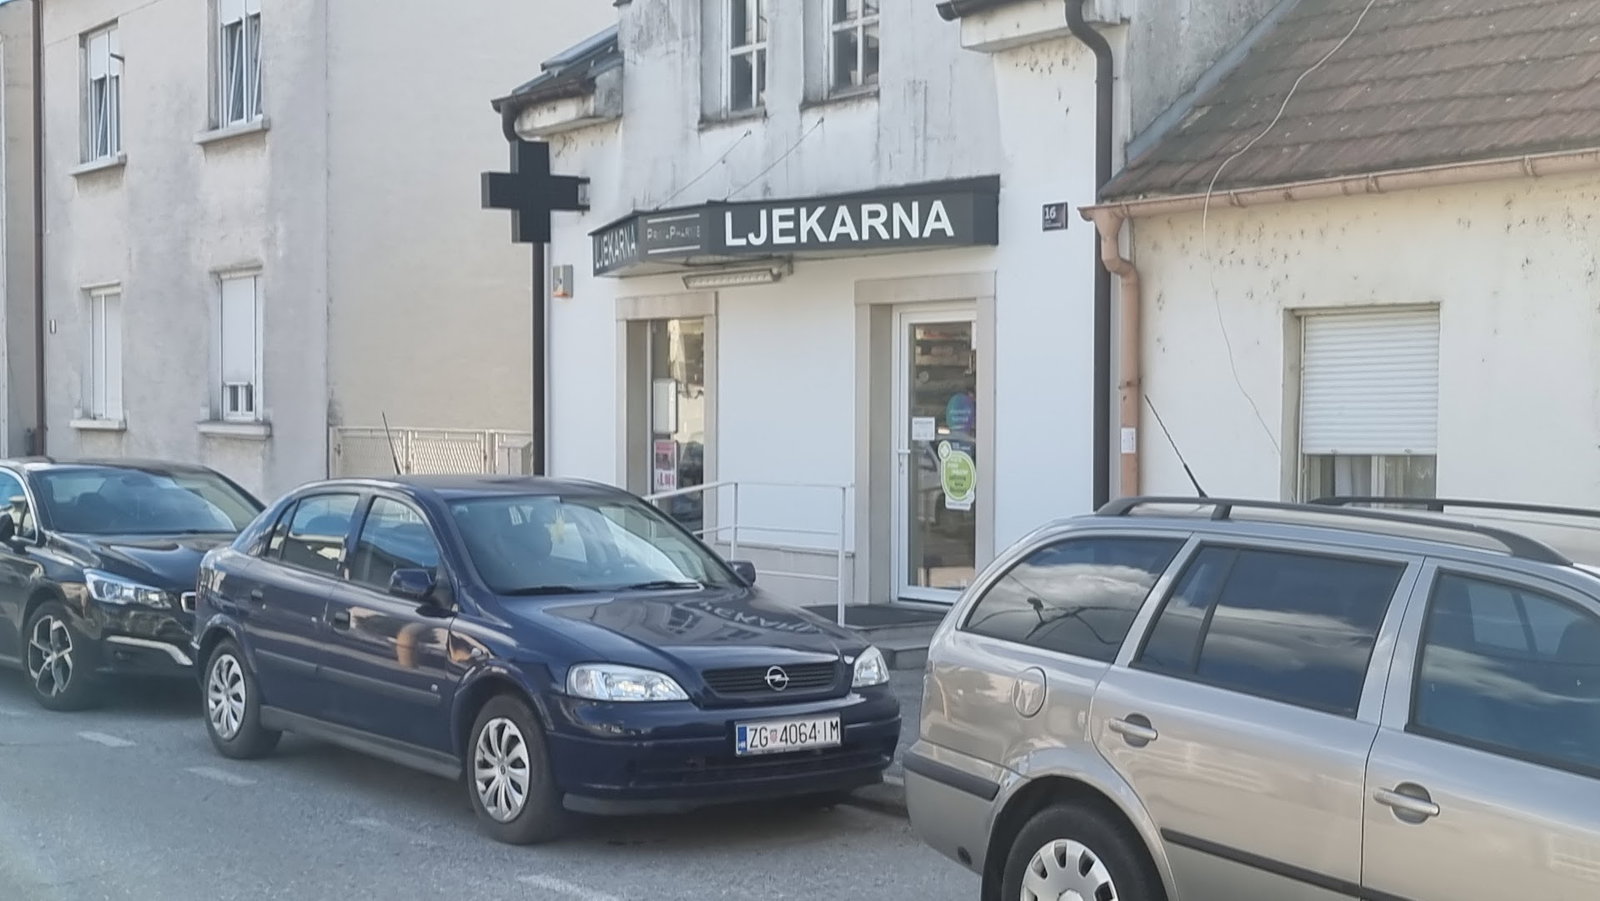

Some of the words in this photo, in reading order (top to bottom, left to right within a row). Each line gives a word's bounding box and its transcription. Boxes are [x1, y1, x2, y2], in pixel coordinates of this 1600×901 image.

[725, 200, 954, 246] LJEKARNA
[1045, 206, 1056, 220] 16
[594, 224, 636, 269] LJEKARNA
[749, 726, 769, 749] ZG
